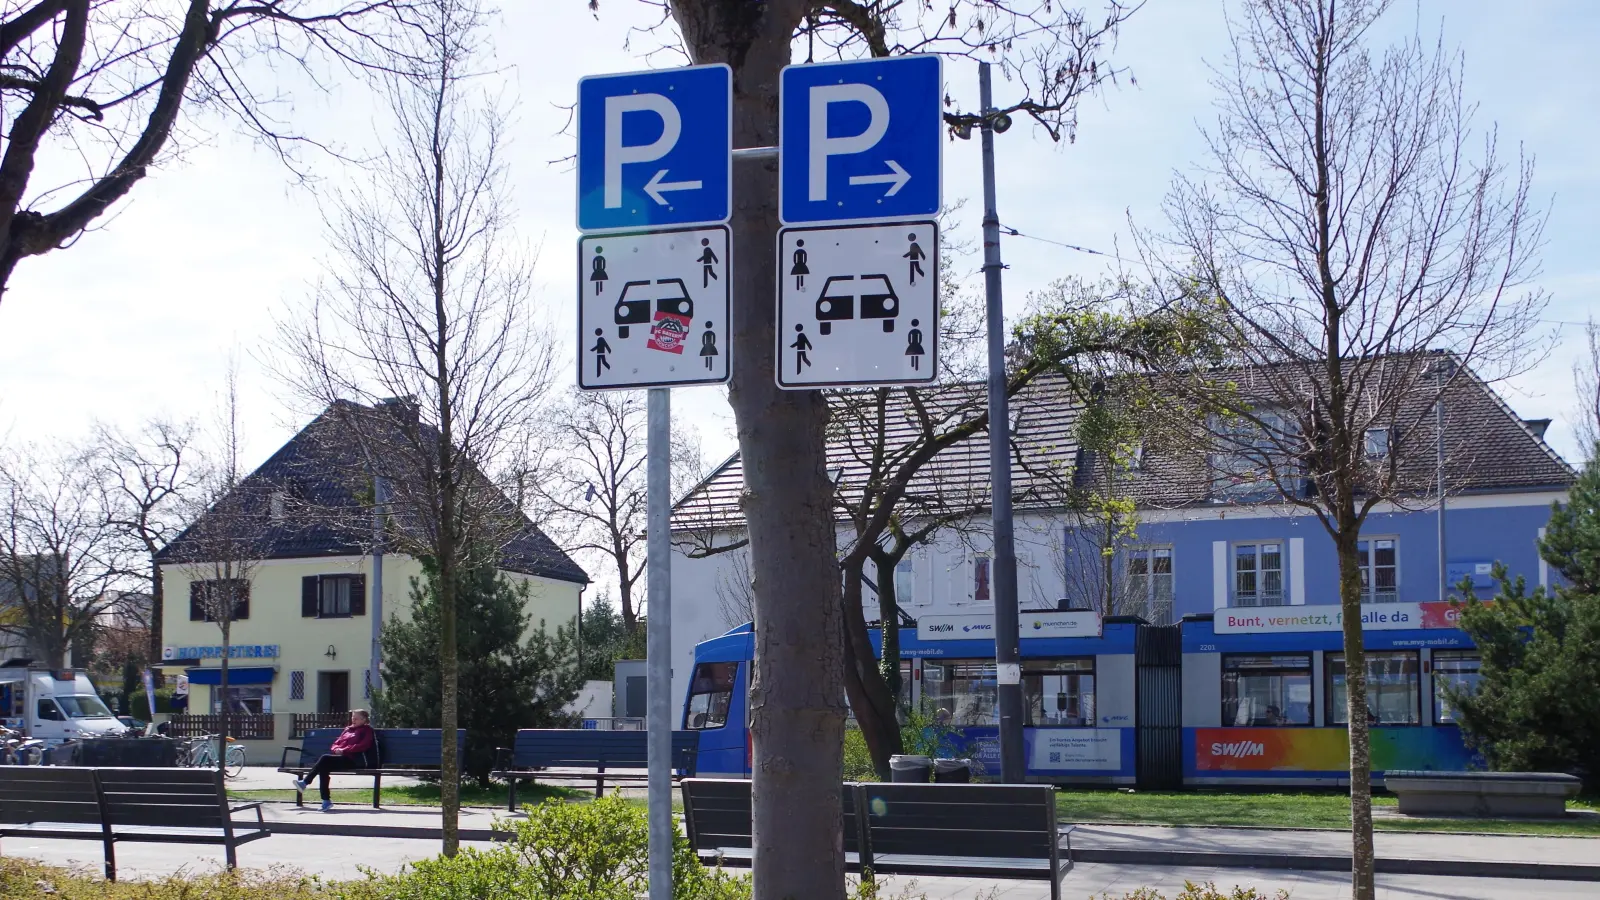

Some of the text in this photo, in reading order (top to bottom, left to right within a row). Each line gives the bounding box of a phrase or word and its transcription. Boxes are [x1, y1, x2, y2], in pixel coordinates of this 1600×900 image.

[809, 83, 890, 202] P
[604, 93, 682, 209] P
[1228, 616, 1265, 627] Bunt,
[1269, 614, 1333, 626] vernetzt,
[1361, 611, 1387, 623] alle
[1391, 611, 1409, 622] da
[1392, 638, 1459, 646] www.mvg-mobil.de
[178, 645, 278, 659] HOFPFSTEREI
